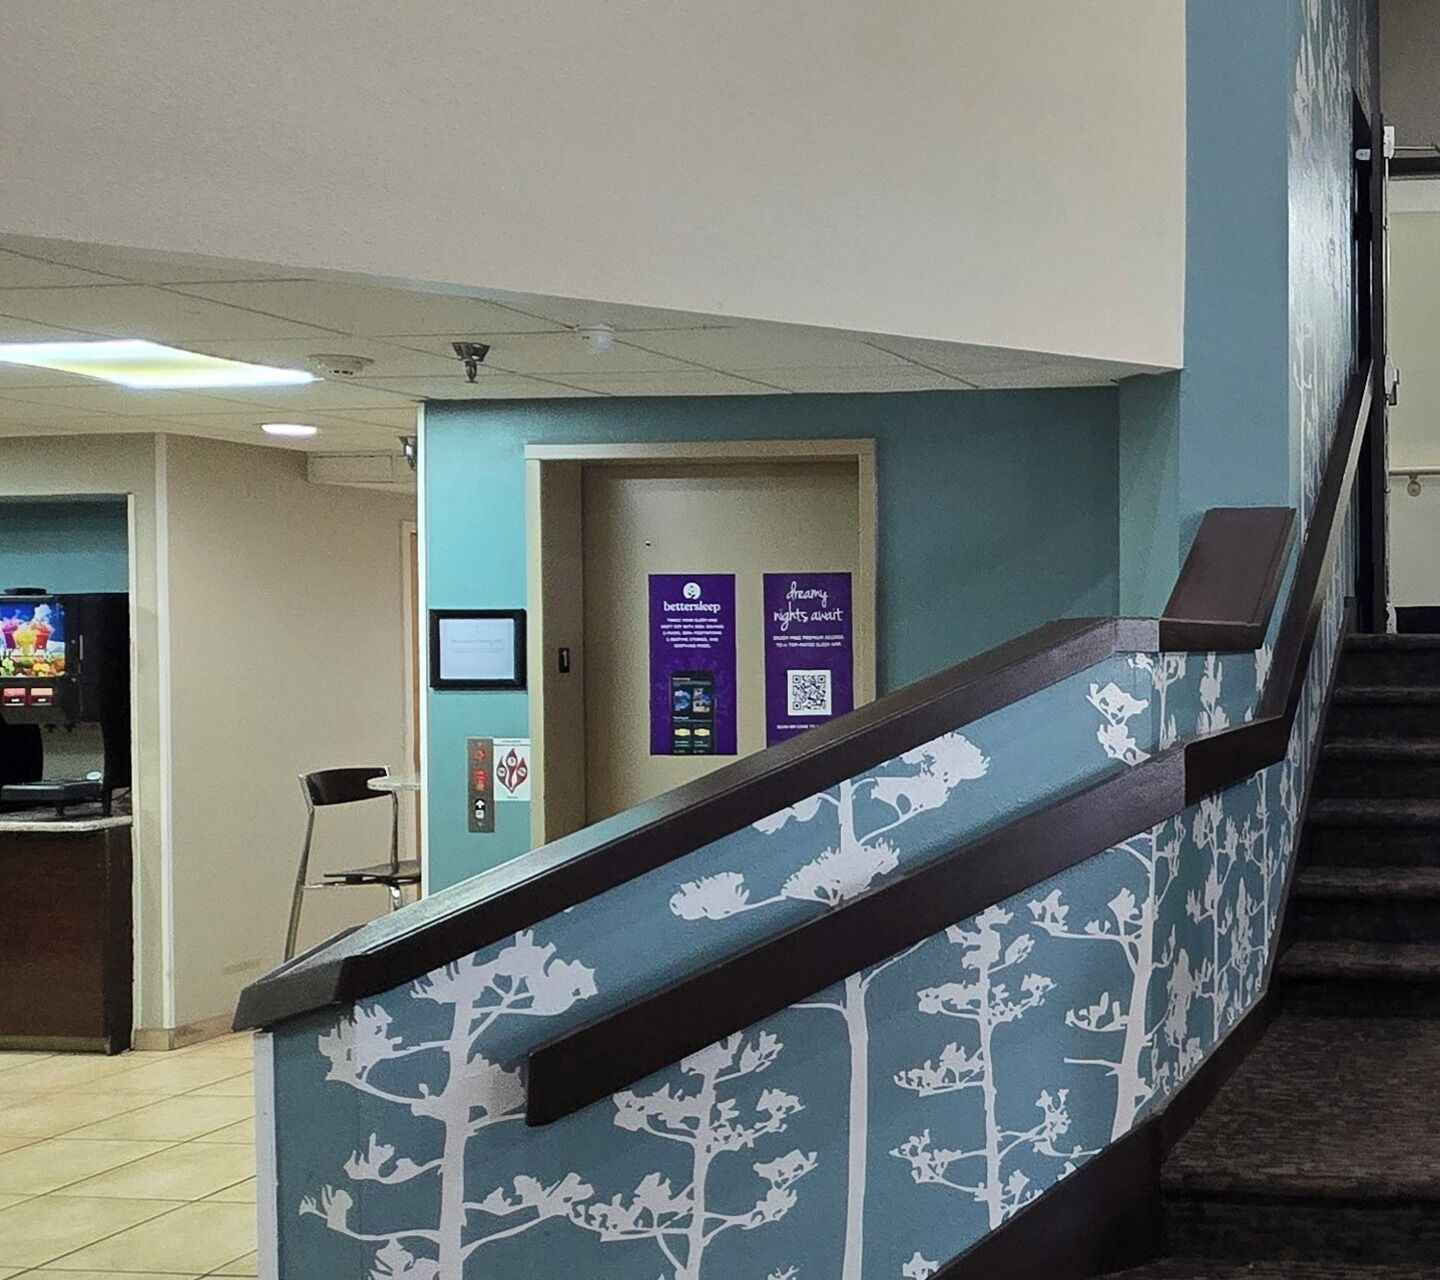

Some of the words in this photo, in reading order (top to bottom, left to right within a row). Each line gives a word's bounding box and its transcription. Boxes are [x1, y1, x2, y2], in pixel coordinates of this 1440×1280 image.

[663, 600, 721, 614] bettersleep
[786, 580, 828, 608] dreamy
[773, 601, 808, 631] nights
[810, 607, 844, 622] await
